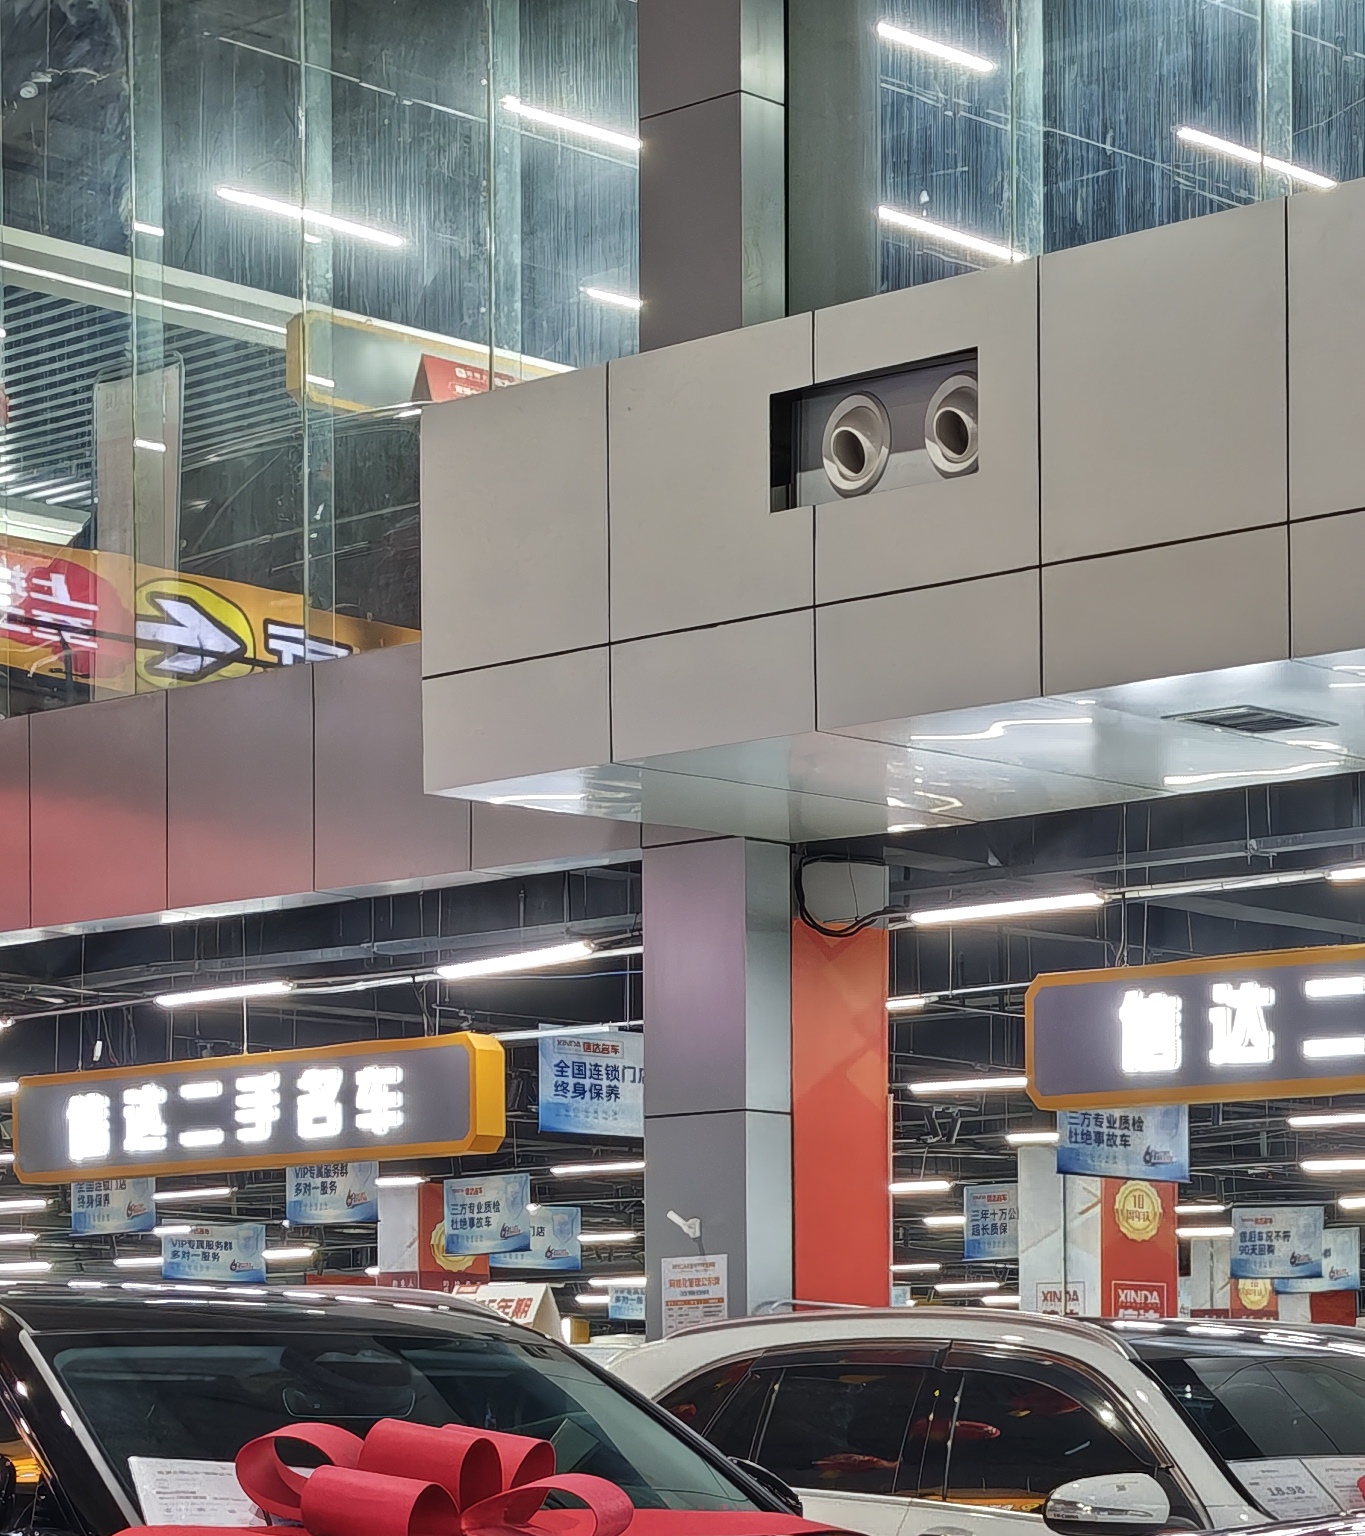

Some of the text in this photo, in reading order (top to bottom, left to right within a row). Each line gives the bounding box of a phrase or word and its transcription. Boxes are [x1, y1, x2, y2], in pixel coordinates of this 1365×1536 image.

[582, 1042, 621, 1055] 信达名车
[553, 1081, 621, 1102] 终身保养
[1067, 1111, 1144, 1133] 三方专业质检
[1067, 1130, 1132, 1149] 杜绝事故车
[293, 1181, 338, 1197] 多对一服务
[450, 1200, 501, 1217] 三方专业质检
[450, 1215, 493, 1231] 杜绝事故车
[971, 1222, 1009, 1237] 超长质保
[170, 1238, 234, 1252] VIP专属服务群
[170, 1249, 221, 1263] 多对一服务
[1116, 1289, 1161, 1304] XINDA
